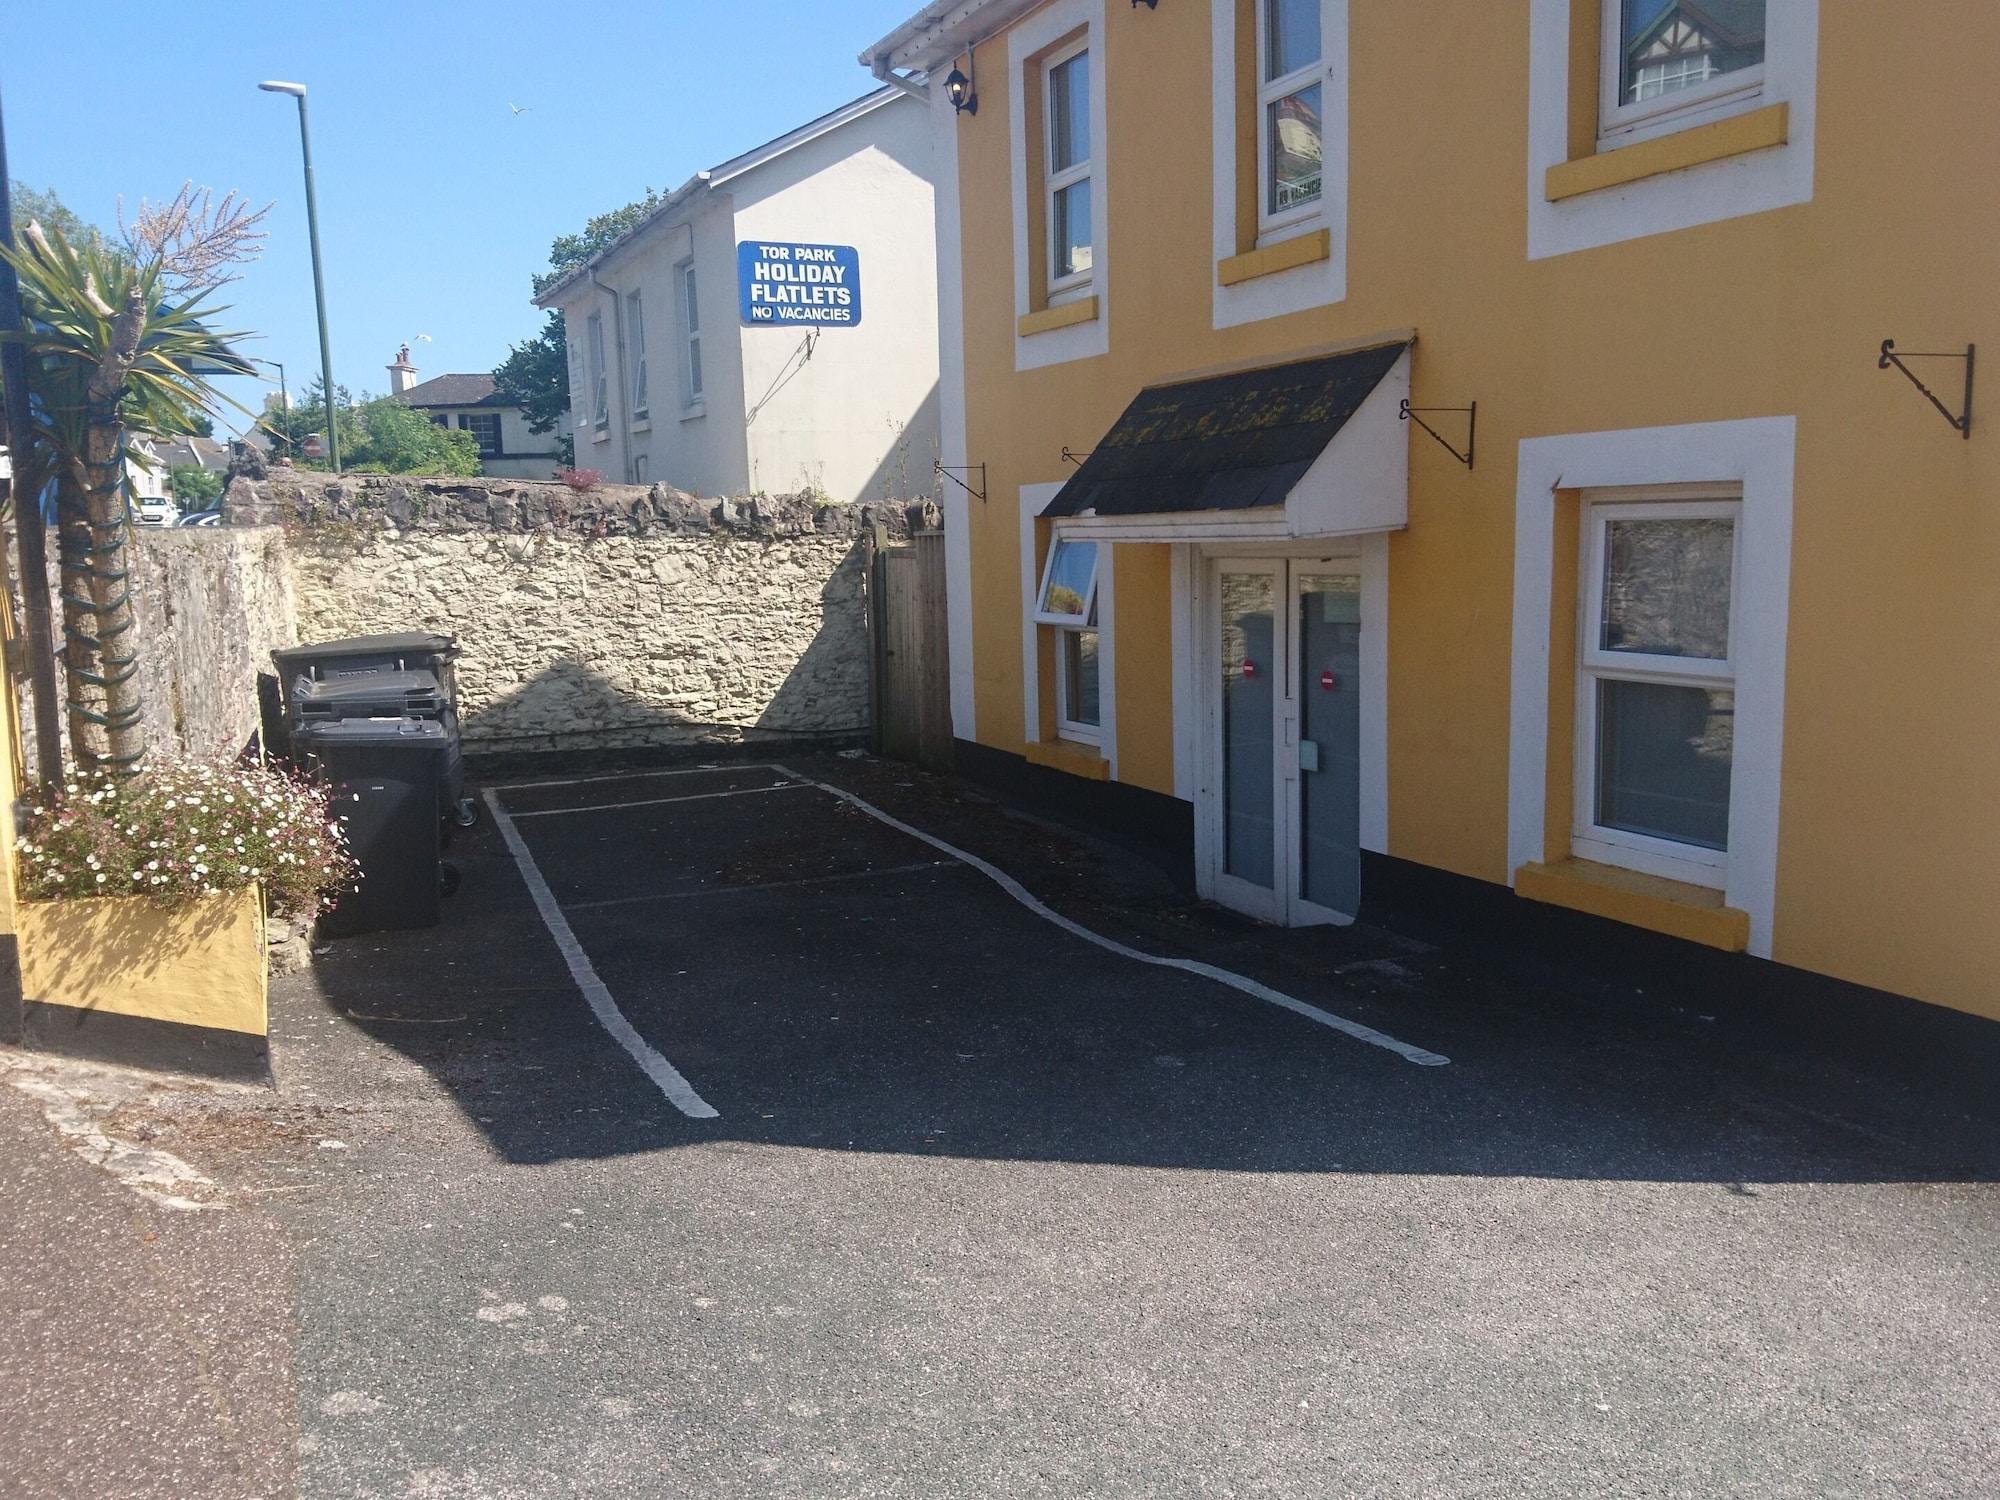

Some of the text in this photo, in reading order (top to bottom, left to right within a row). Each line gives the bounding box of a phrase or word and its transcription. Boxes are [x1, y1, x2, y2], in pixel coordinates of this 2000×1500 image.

[759, 246, 836, 262] TOR PARK
[754, 262, 846, 284] HOLIDAY
[750, 283, 851, 305] FLATLETS
[752, 306, 851, 321] NO VACANCIES
